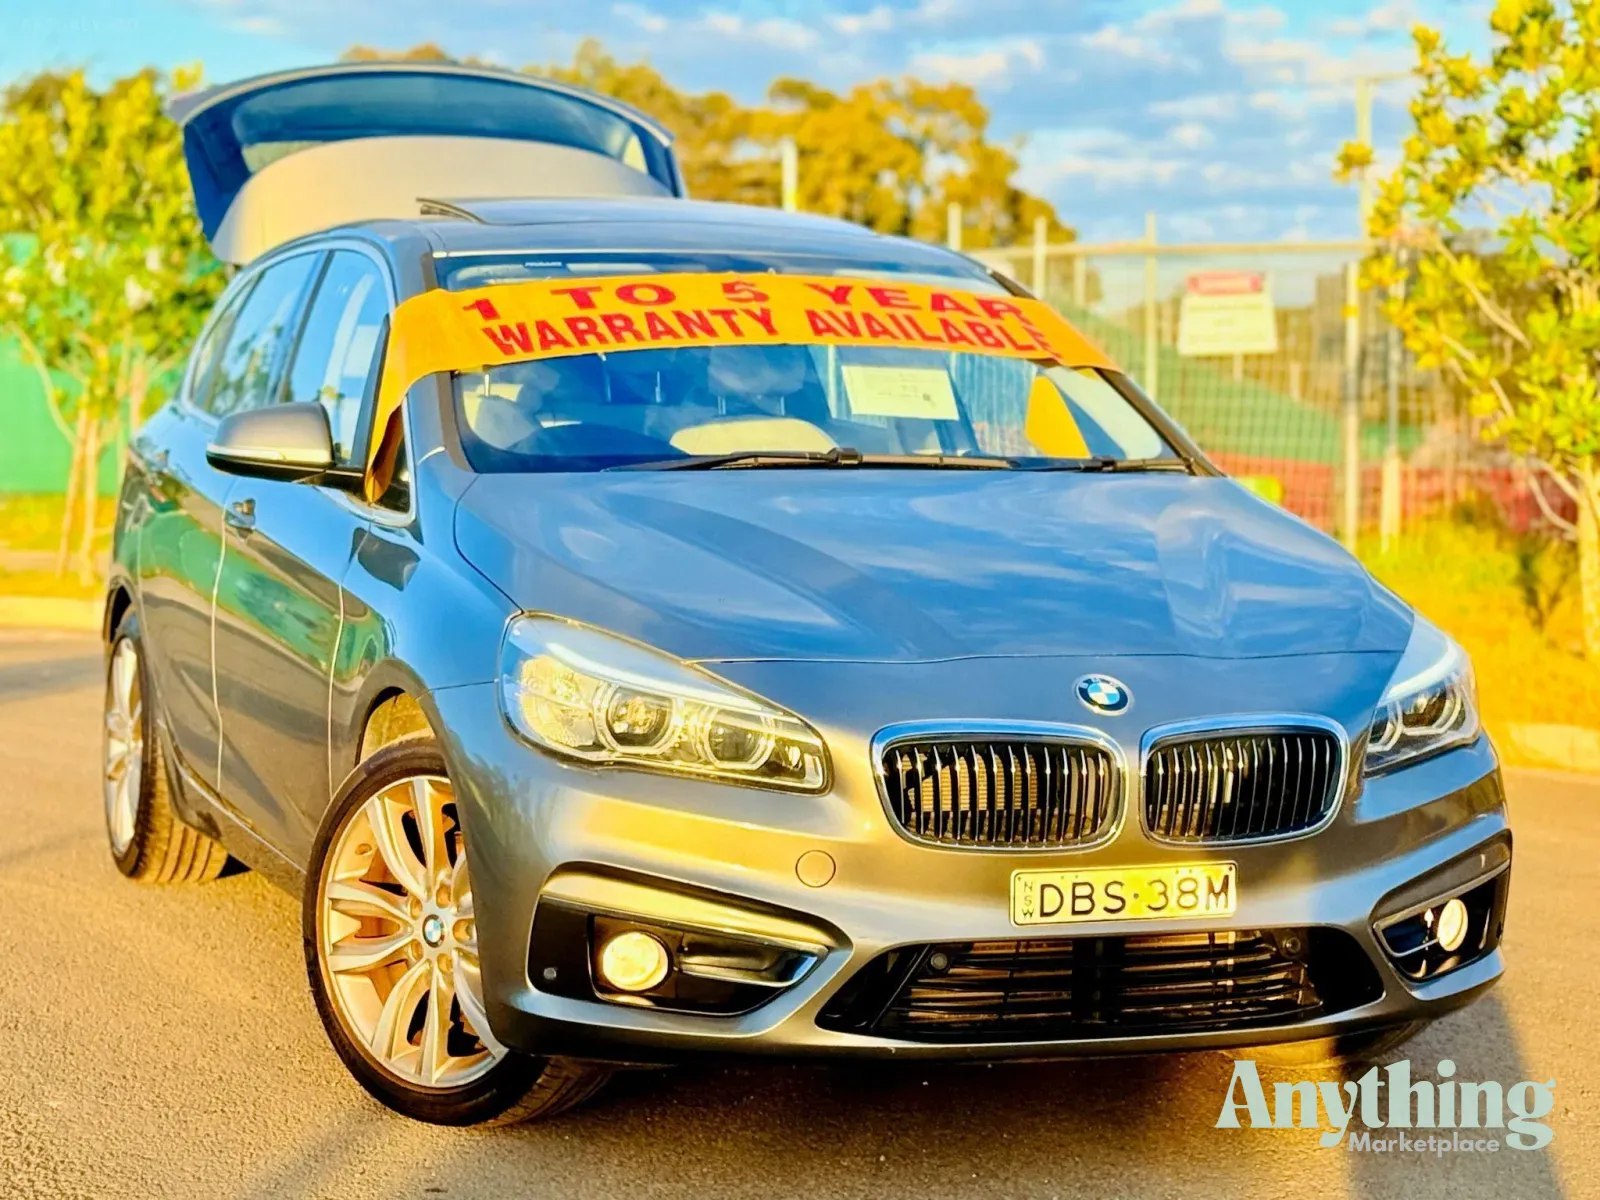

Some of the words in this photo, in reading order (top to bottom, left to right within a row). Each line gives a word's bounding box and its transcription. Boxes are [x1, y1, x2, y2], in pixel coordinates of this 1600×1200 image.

[463, 298, 501, 321] 1
[550, 283, 677, 310] TO
[721, 280, 770, 303] 5
[806, 283, 1034, 325] YEAR
[481, 307, 779, 356] WARRANTY
[804, 310, 1063, 359] AVAILABLE
